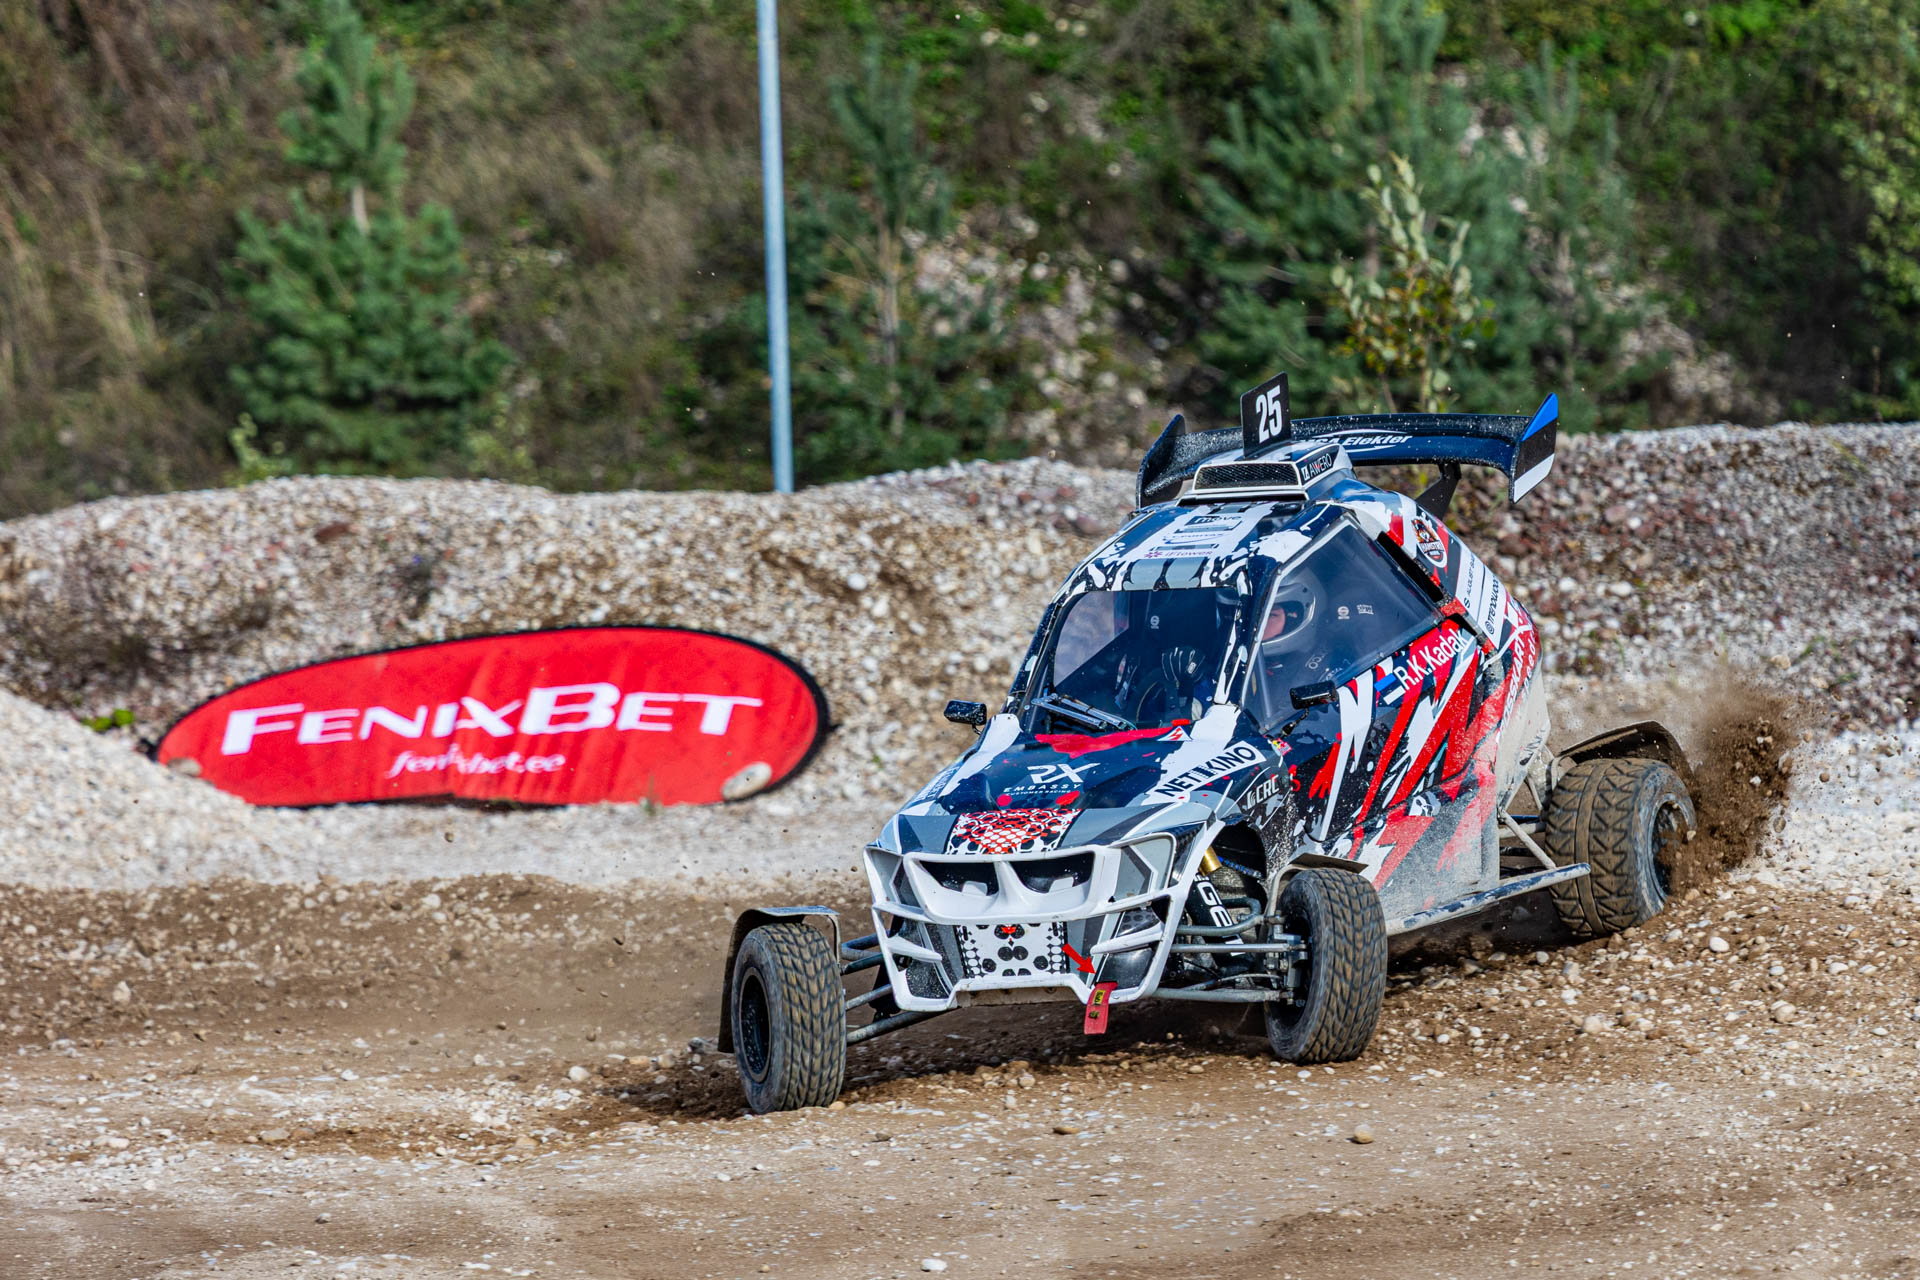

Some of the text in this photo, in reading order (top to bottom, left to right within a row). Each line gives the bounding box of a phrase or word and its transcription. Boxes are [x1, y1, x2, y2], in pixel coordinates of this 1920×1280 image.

[1256, 385, 1282, 443] 25
[1342, 435, 1412, 446] Elekter
[1309, 453, 1332, 478] AWERO
[1394, 628, 1470, 691] R.K.Kadak
[1003, 784, 1082, 793] EMBASSY
[1256, 775, 1280, 803] CRC
